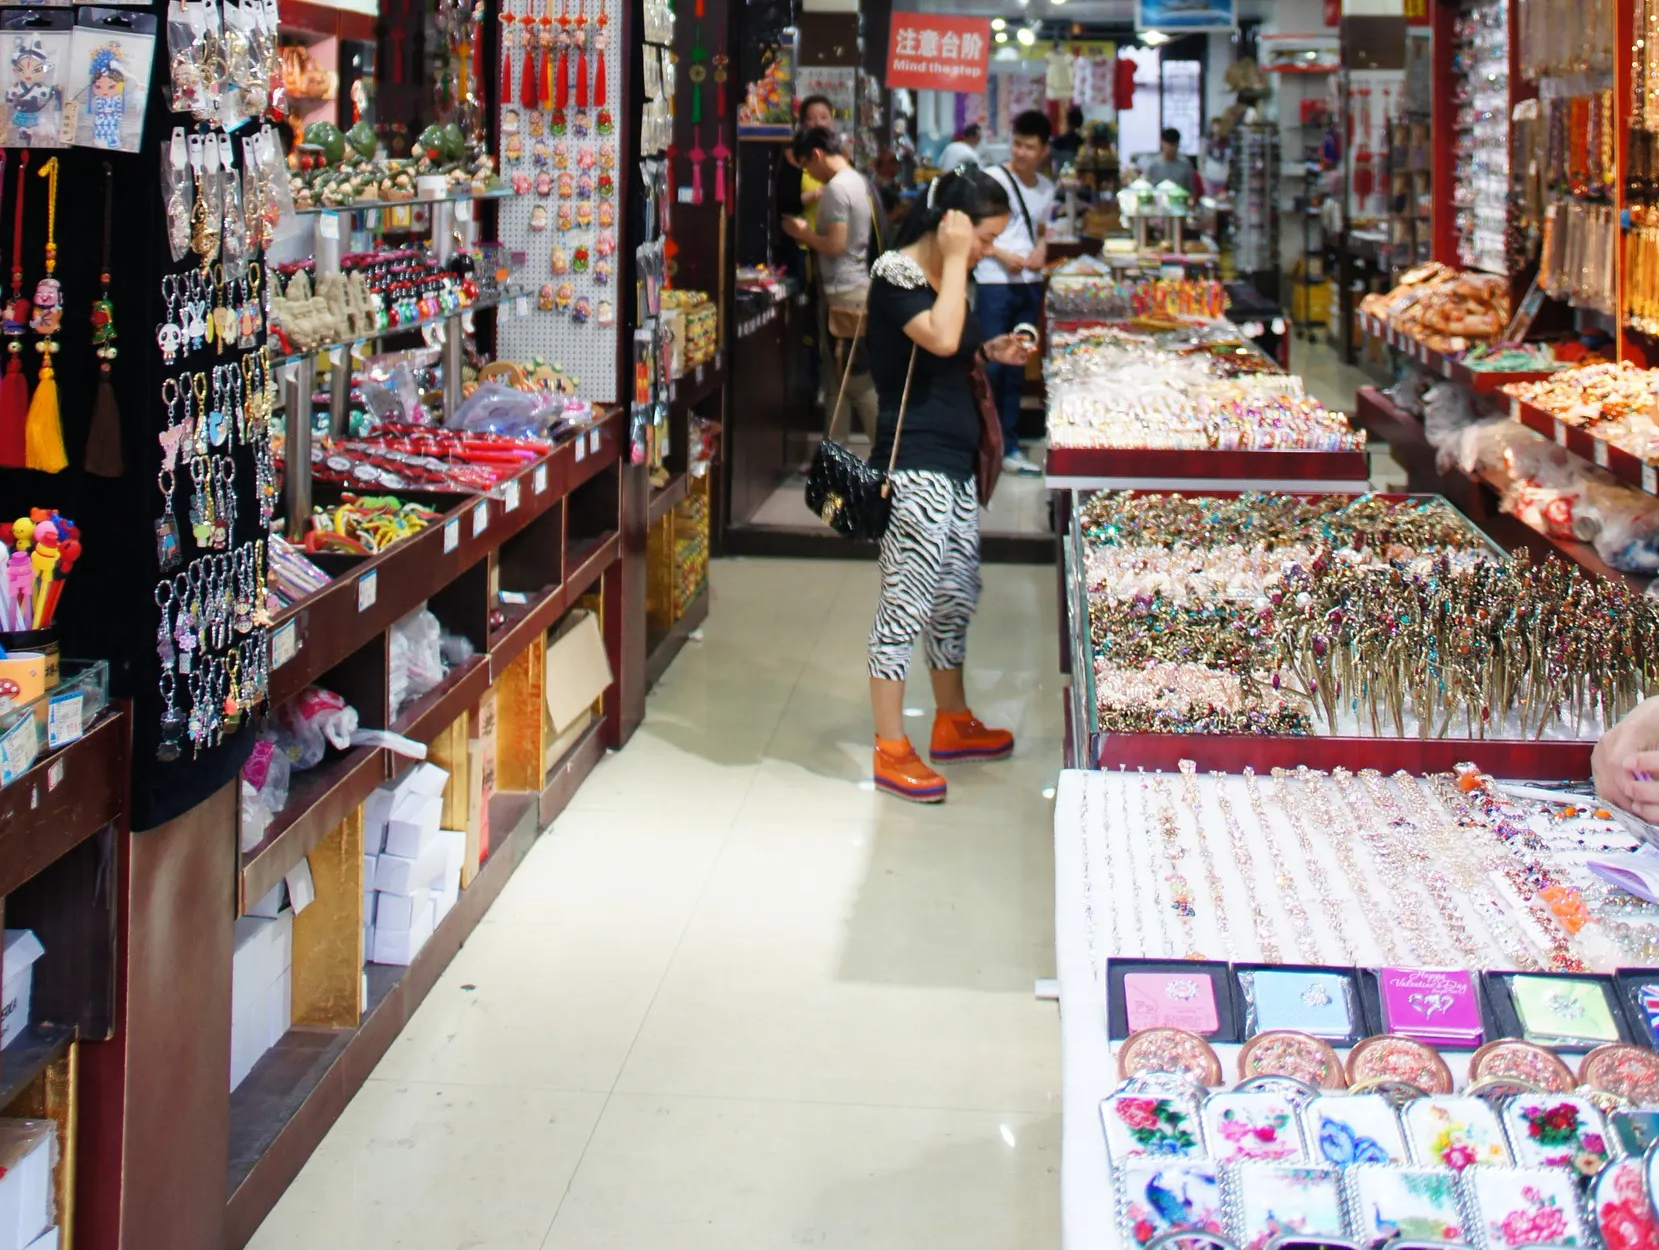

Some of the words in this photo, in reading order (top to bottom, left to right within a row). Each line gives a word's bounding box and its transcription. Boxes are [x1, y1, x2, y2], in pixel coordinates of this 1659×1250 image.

[895, 28, 983, 60] 注意台阶
[893, 59, 926, 73] Mind
[929, 61, 950, 75] the
[1409, 971, 1446, 982] Happy
[1443, 980, 1467, 994] Day
